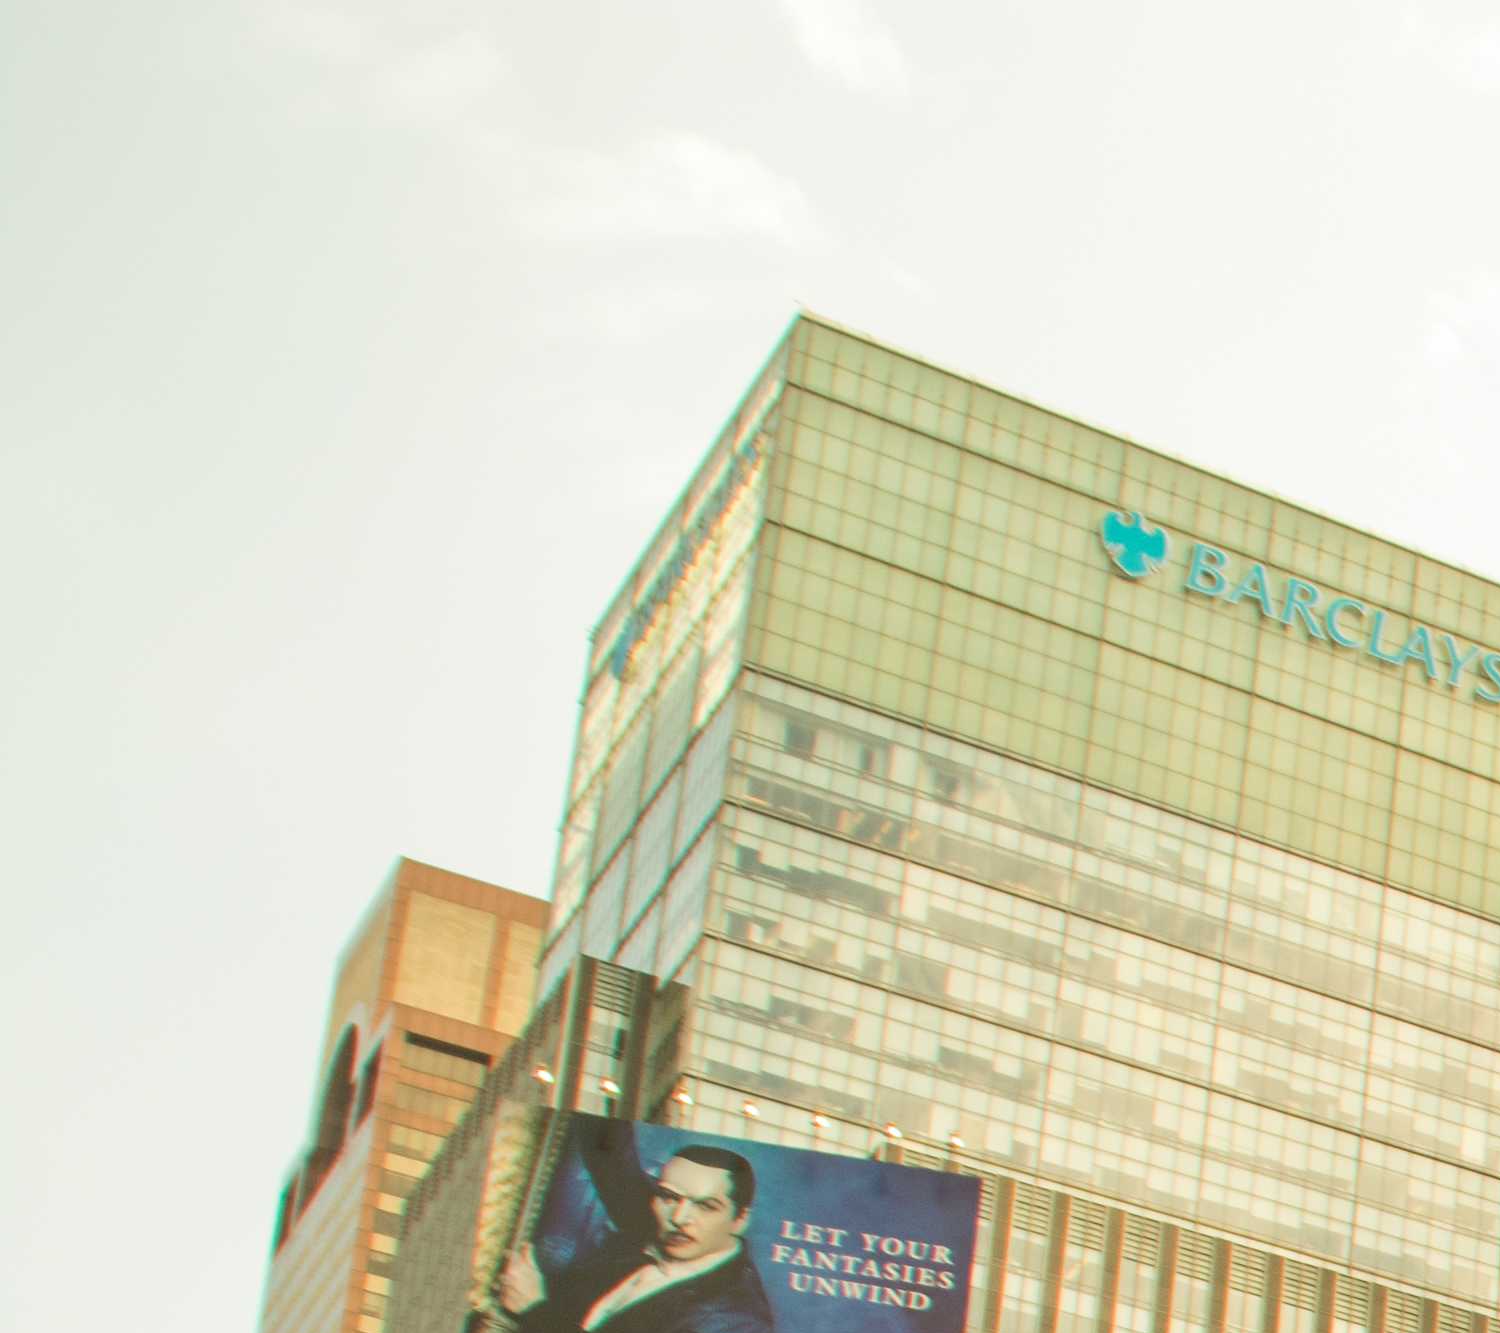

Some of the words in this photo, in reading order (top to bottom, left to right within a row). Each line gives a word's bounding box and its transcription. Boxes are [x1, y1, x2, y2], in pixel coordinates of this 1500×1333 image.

[779, 1219, 845, 1249] LET
[861, 1232, 956, 1266] YOUR
[771, 1244, 956, 1292] FANTASIES
[788, 1271, 932, 1312] UNWIND
